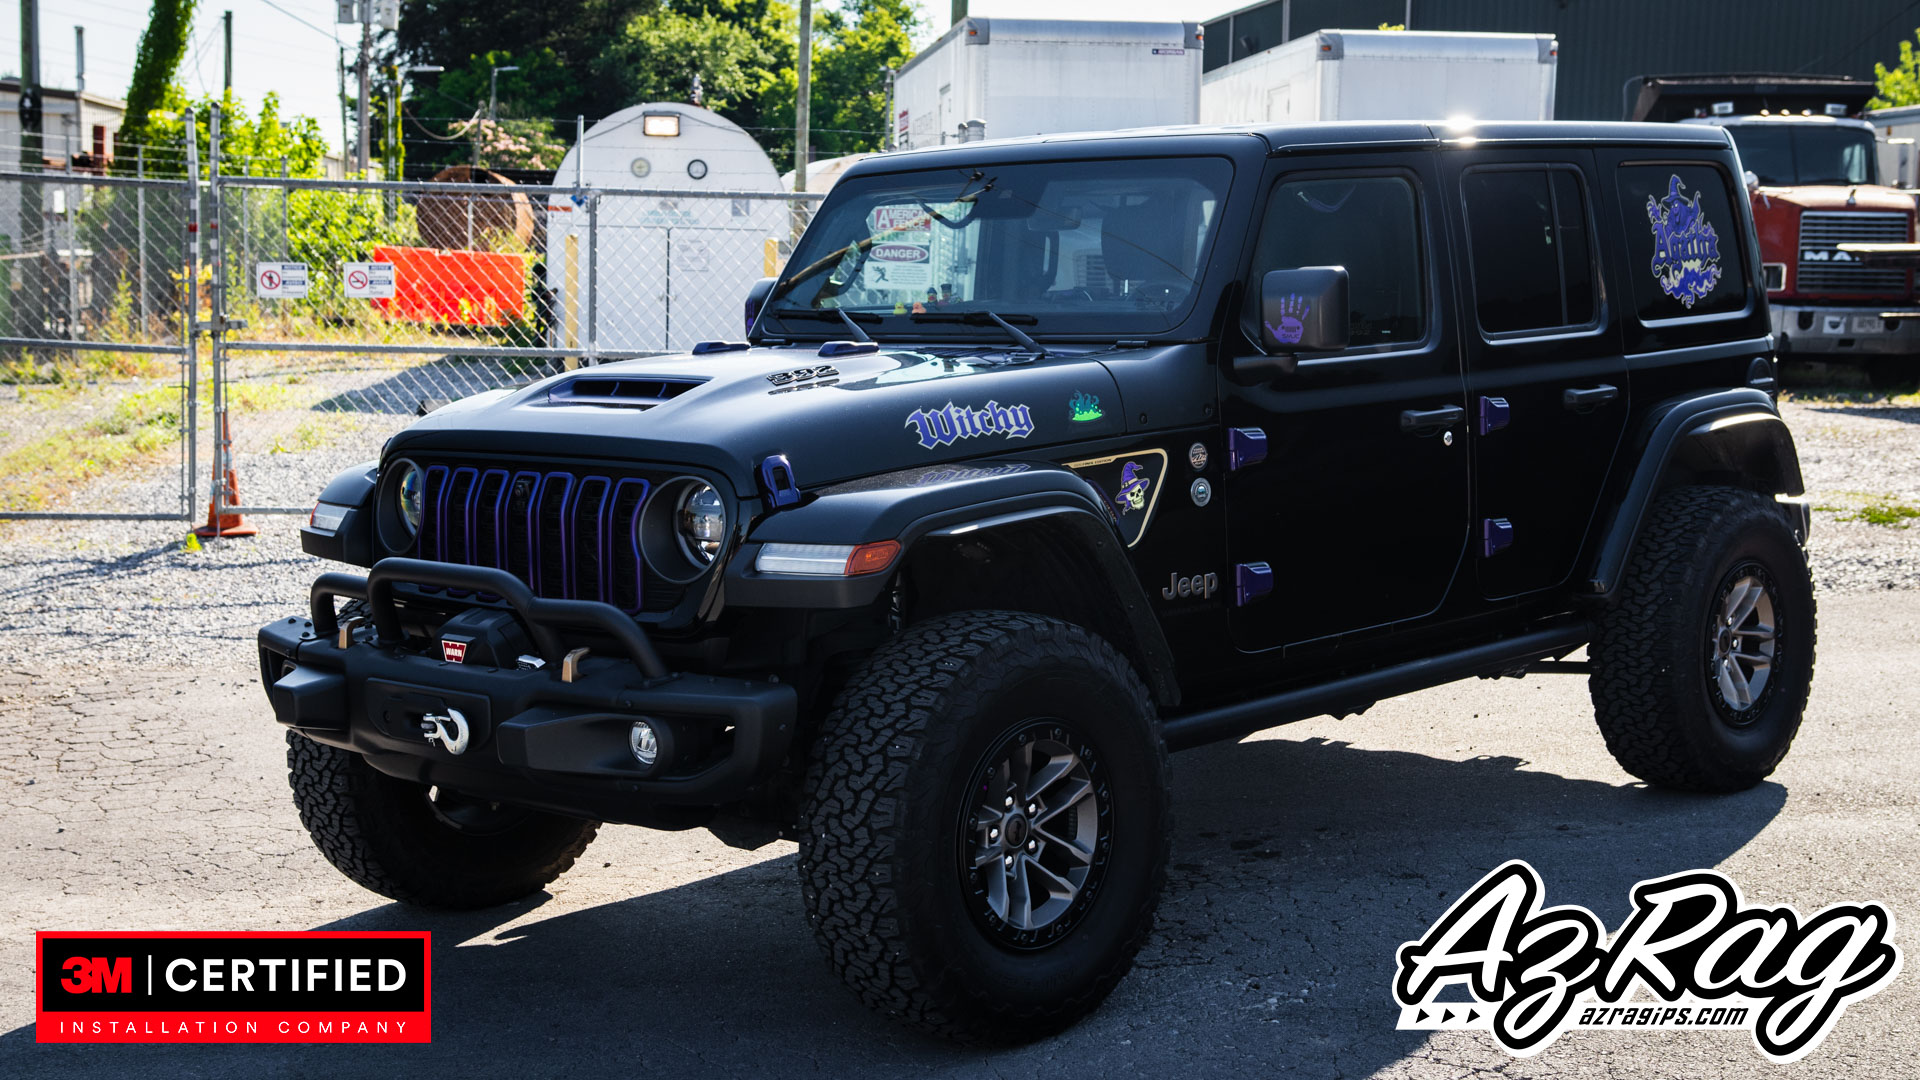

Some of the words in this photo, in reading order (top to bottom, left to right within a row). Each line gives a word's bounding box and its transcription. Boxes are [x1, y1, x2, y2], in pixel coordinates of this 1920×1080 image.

[875, 248, 921, 259] DANGER
[1652, 220, 1720, 280] Agatha
[766, 366, 840, 387] 392
[904, 400, 1035, 449] Witchy
[1162, 572, 1218, 600] Jeep
[446, 647, 463, 658] WARN
